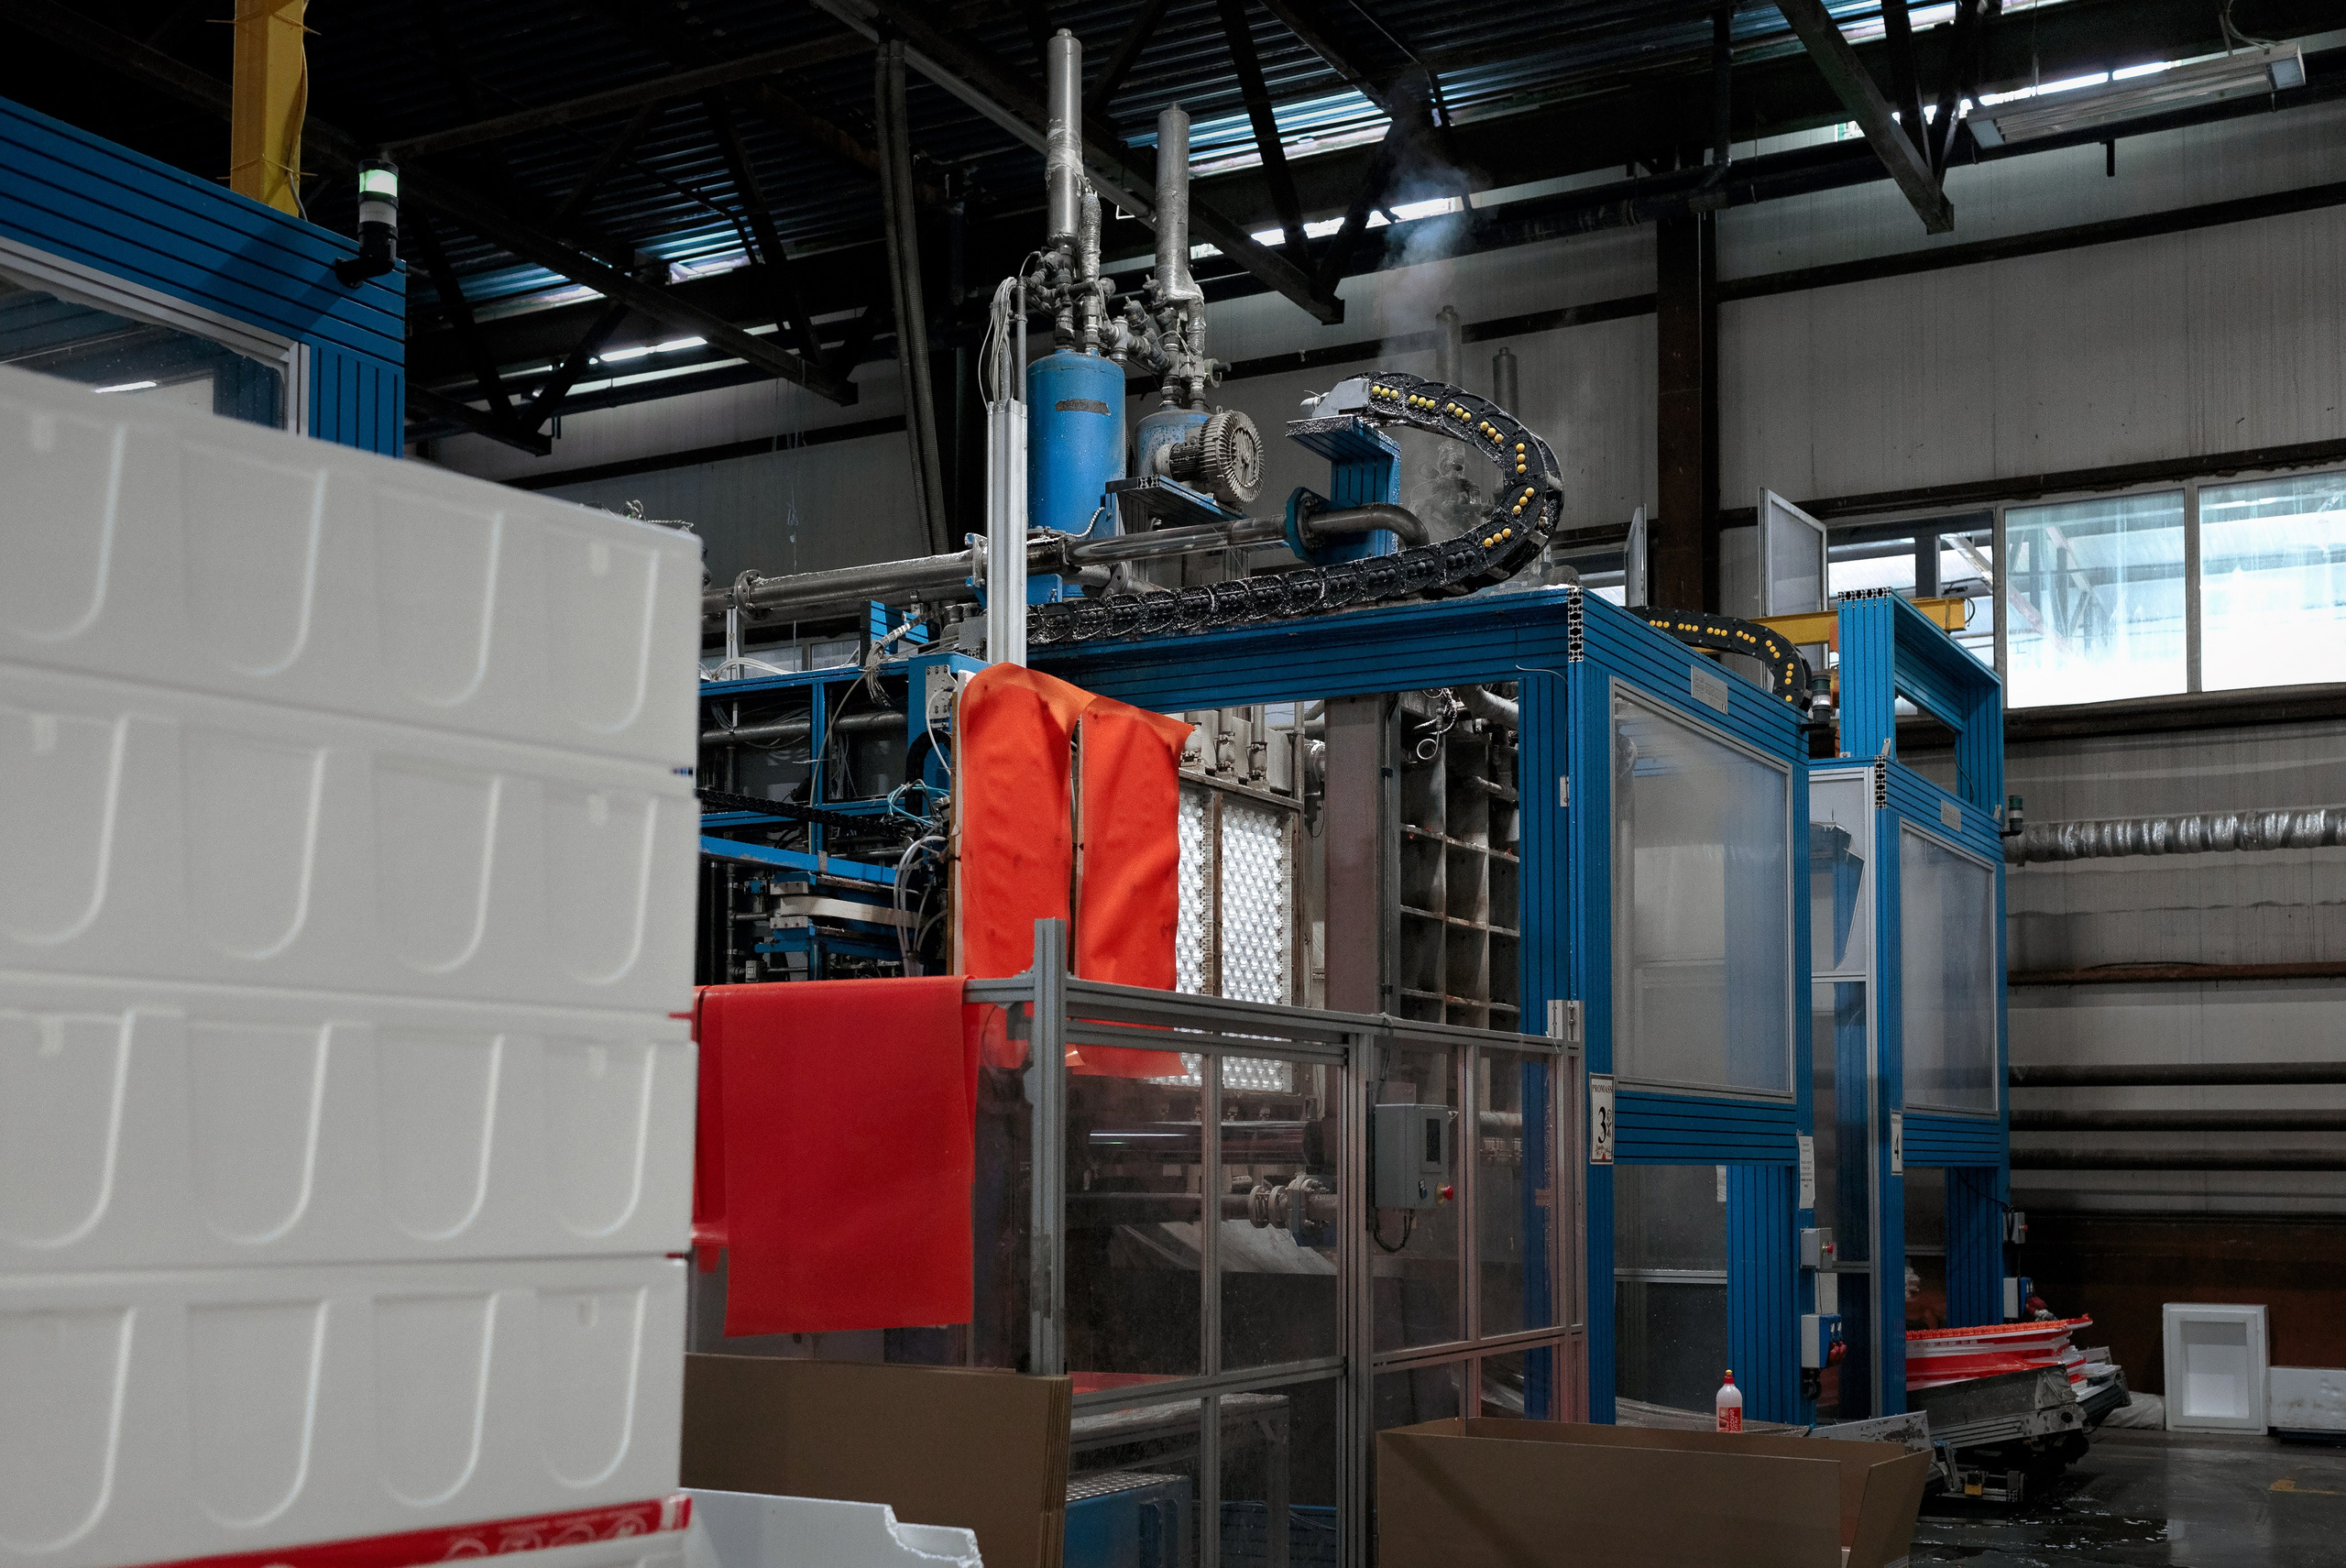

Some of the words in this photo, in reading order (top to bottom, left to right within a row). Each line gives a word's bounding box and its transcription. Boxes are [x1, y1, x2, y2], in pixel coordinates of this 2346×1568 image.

[1592, 1084, 1613, 1093] PROMASS
[1598, 1106, 1606, 1144] 3
[1894, 1134, 1900, 1160] 4
